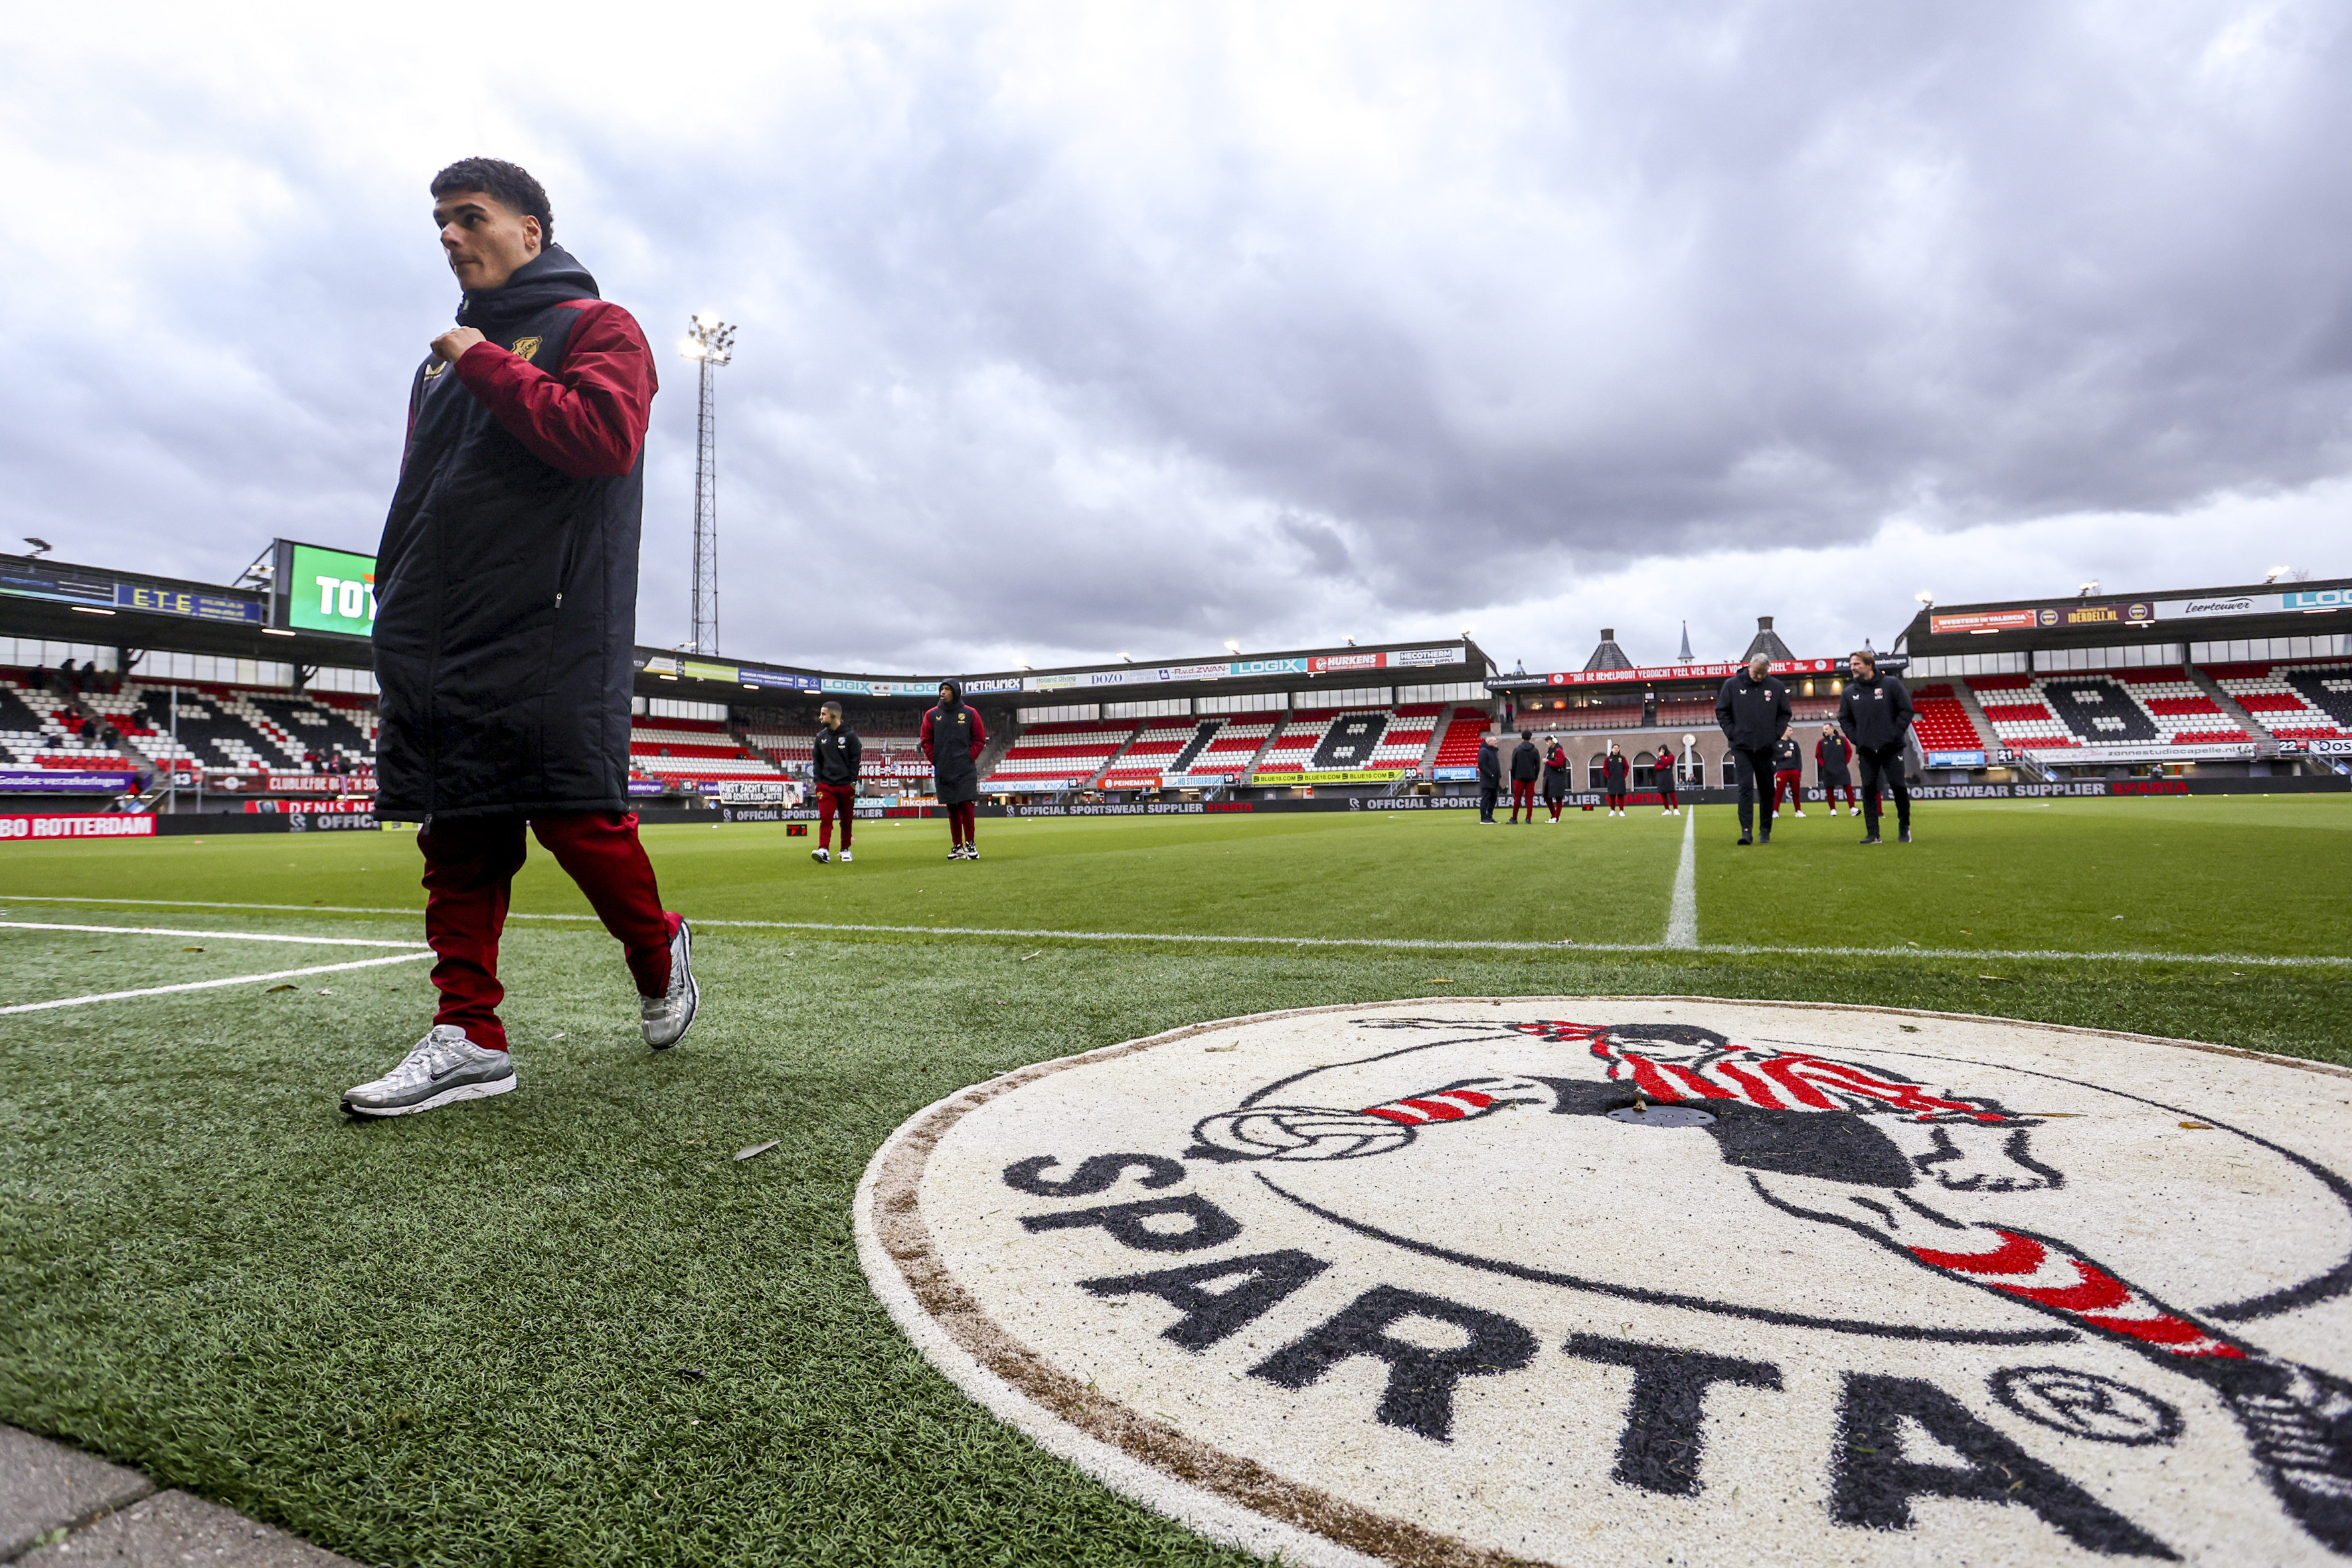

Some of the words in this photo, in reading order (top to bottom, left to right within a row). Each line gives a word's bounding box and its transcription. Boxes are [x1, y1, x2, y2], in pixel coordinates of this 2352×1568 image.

[133, 588, 192, 612] ETE
[2185, 601, 2250, 613] Leertouwer
[1938, 617, 1979, 625] INVESTEER
[1988, 614, 2026, 623] VALENCIA
[2068, 610, 2118, 623] IBERDELI.NL
[1327, 654, 1377, 666] HURKENS
[1400, 649, 1452, 660] HECOTHERM
[1239, 659, 1302, 673] LOGIX
[1092, 673, 1122, 684] DOZO
[1587, 672, 1595, 681] DE
[1596, 670, 1636, 681] HEMELPOORT
[1638, 668, 1671, 678] VERDACHT
[1673, 666, 1689, 676] VEEL
[1691, 666, 1706, 676] WEG
[1707, 665, 1726, 675] HEEFT
[823, 679, 871, 694] LOGIX
[966, 678, 1020, 692] METALIMEX
[2108, 746, 2236, 757] zonnestudiocapelle.nl
[2279, 741, 2298, 751] 22
[1934, 753, 1977, 763] bictgroep
[1998, 749, 2012, 760] 21
[895, 765, 929, 777] NAREN
[1406, 769, 1417, 777] 20
[1438, 768, 1471, 777] bictgroep
[42, 775, 126, 788] verzekeringen
[173, 773, 191, 785] 13
[683, 781, 692, 789] 15
[1178, 777, 1185, 786] HQ
[721, 783, 738, 793] RUST
[740, 783, 761, 793] ZACHT
[762, 783, 782, 793] SIMON
[1888, 785, 2009, 799] SORTSWEAR
[2015, 783, 2106, 797] SUPPLIER
[2112, 781, 2189, 795] SPARTA
[1020, 806, 1067, 815] OFFICIAL
[1070, 805, 1145, 815] SPORTSWEAR
[1147, 803, 1203, 813] SUPPLIER
[1207, 802, 1254, 812] SPARTA
[1367, 798, 1427, 809] OFFICIAL
[1431, 797, 1526, 808] SPORTSEAR
[736, 810, 779, 821] OFFICIAL
[886, 809, 932, 817] SPARTA
[32, 816, 153, 836] ROTTERDAM
[317, 814, 380, 829] OFFIC
[1003, 1152, 2186, 1563] SPARTA
